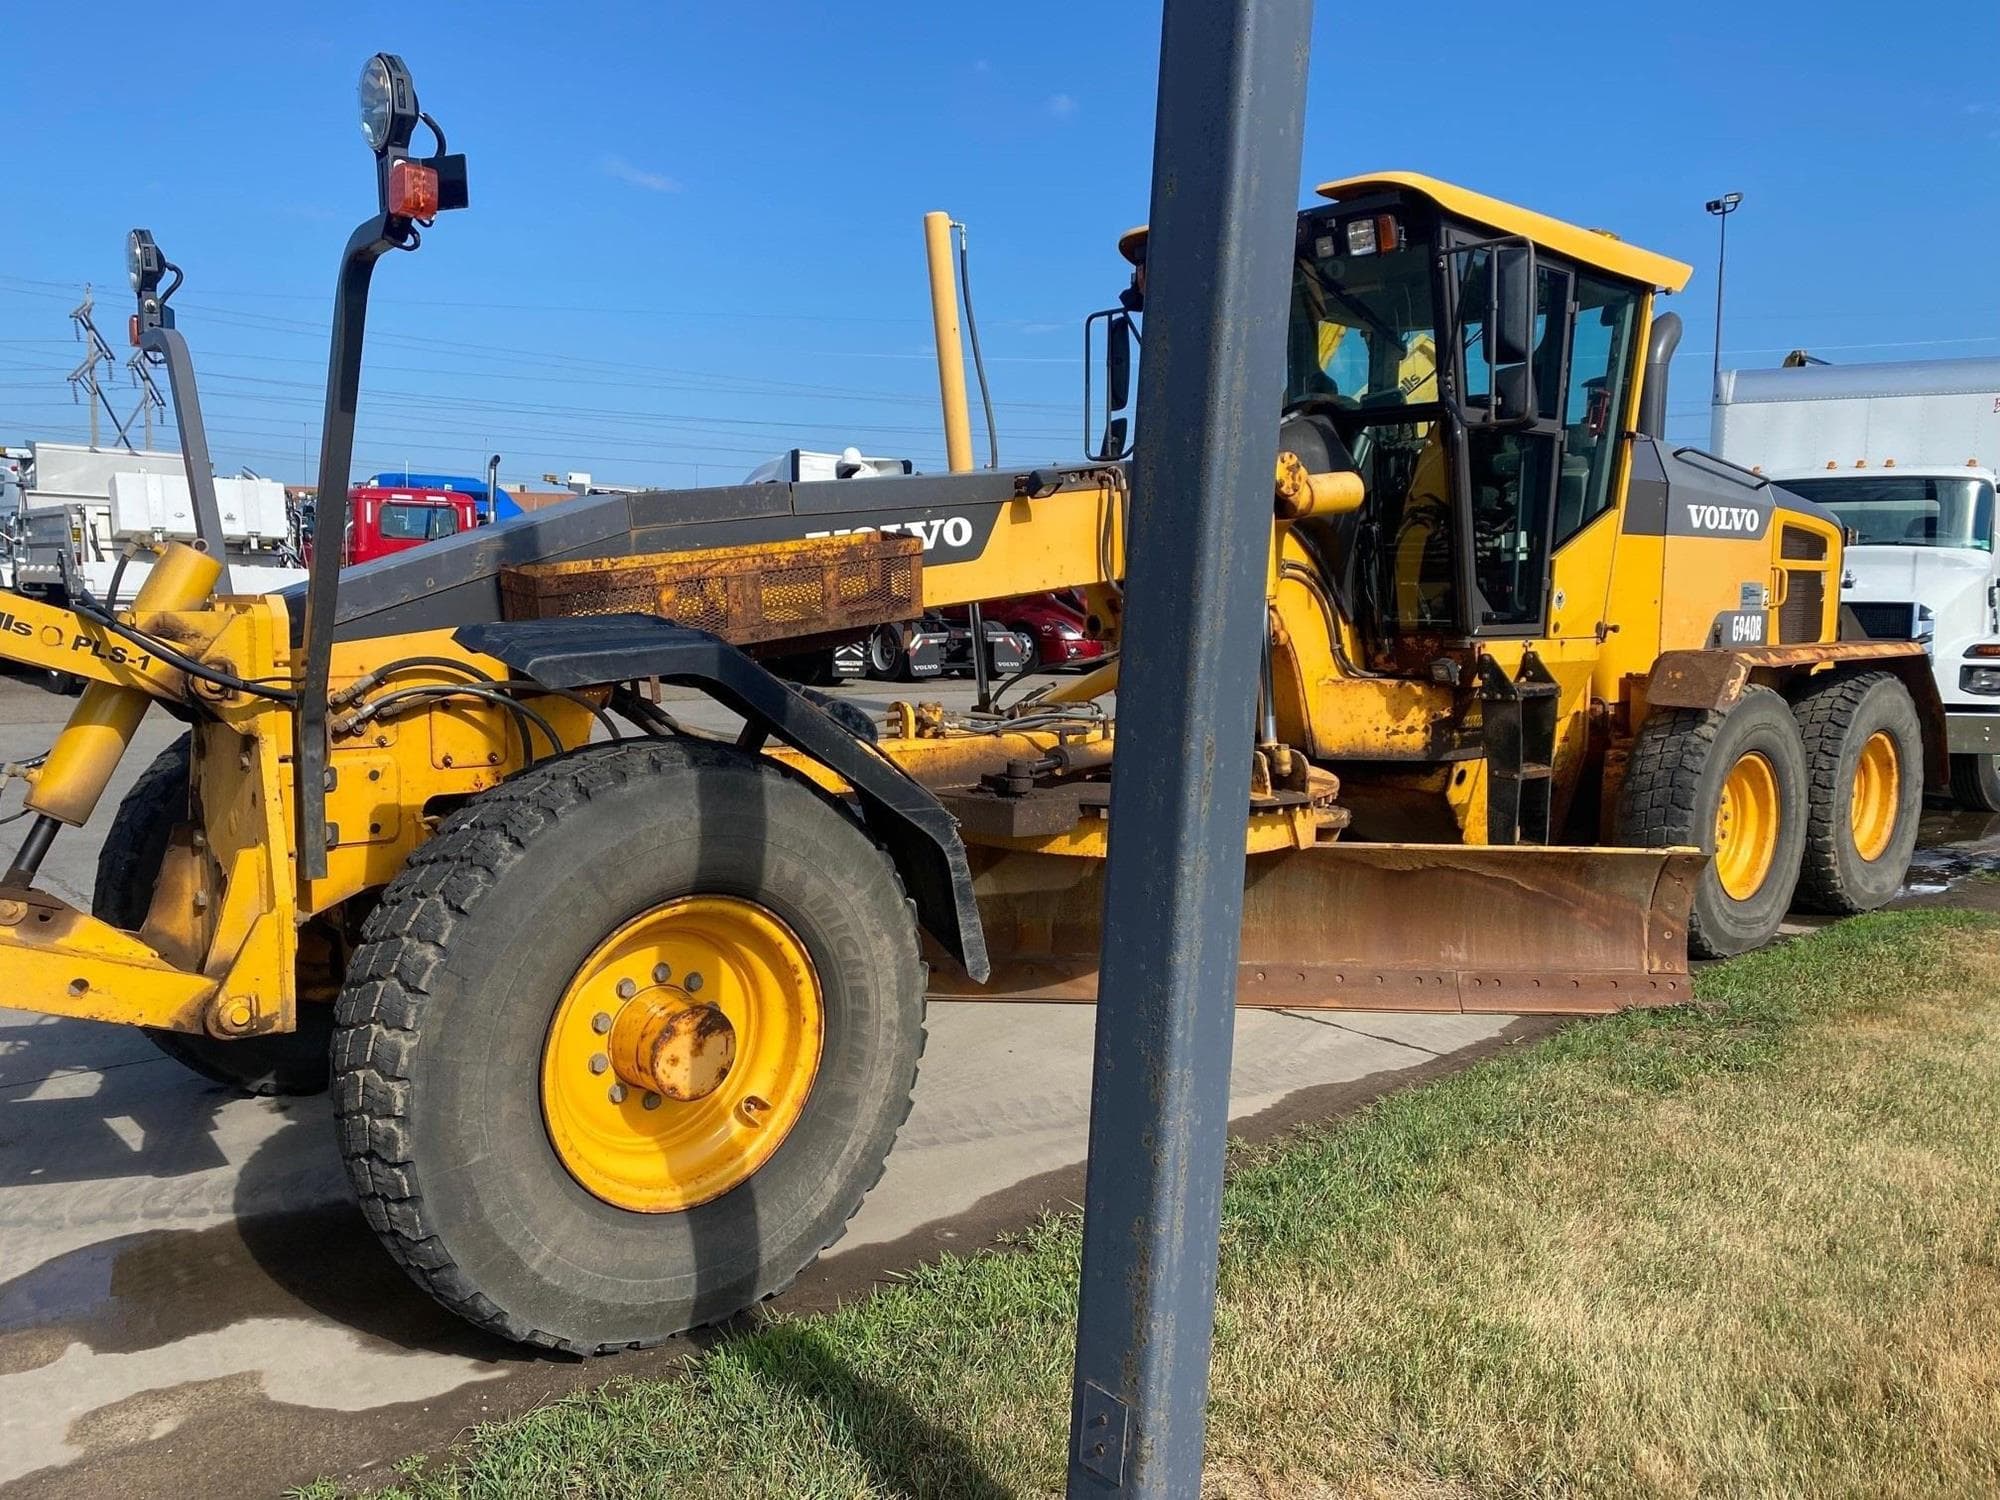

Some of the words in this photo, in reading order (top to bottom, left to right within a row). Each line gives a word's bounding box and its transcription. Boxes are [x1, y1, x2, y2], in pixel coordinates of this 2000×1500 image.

[1687, 505, 1759, 532] VOLVO
[1732, 615, 1762, 641] G940B
[72, 635, 150, 671] PLS-1
[808, 893, 871, 1075] MICHELIN
